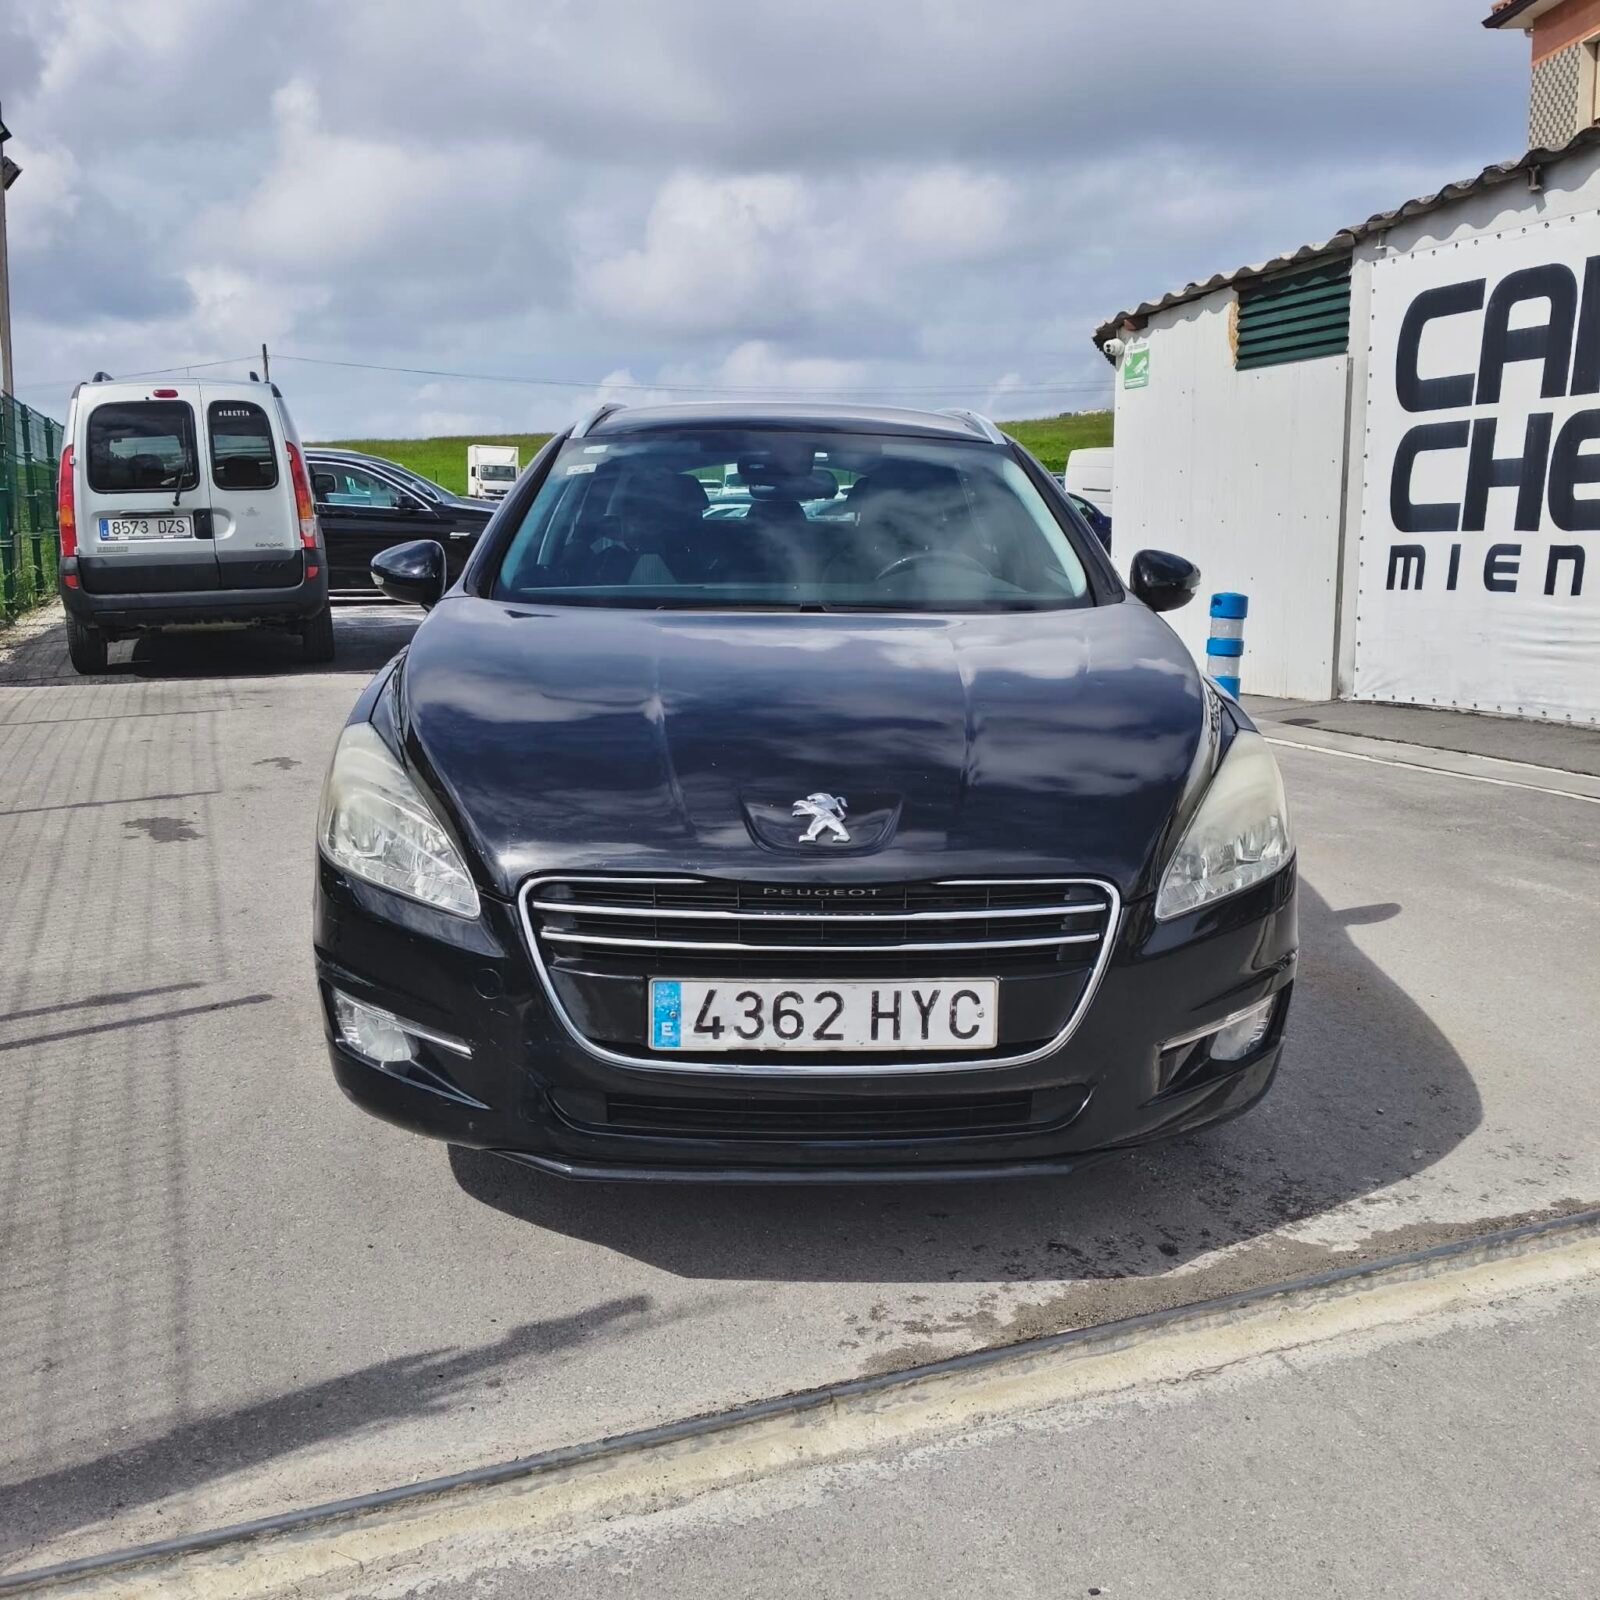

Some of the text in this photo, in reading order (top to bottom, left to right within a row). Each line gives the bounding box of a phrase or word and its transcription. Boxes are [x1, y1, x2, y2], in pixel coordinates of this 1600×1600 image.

[1396, 255, 1600, 413] CA
[1390, 408, 1600, 532] CHE
[112, 520, 149, 535] 8573
[157, 519, 186, 534] DZS
[763, 887, 881, 897] PEUGEOT
[661, 1022, 674, 1037] E
[693, 989, 982, 1041] 4362 HYC
